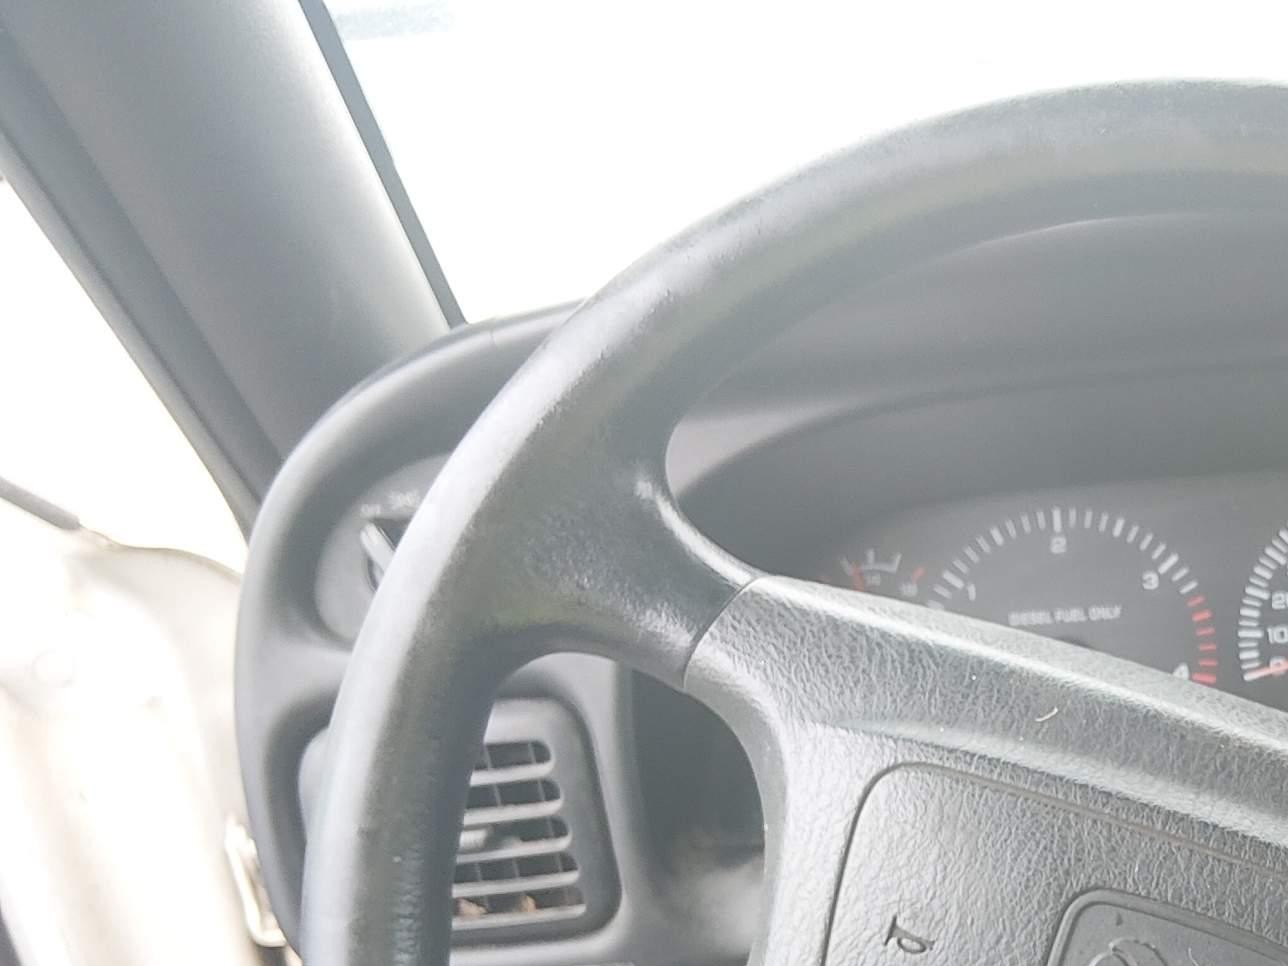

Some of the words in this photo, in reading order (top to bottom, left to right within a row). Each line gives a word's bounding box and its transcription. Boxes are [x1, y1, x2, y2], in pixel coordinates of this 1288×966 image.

[1050, 535, 1067, 554] 2
[1142, 570, 1160, 590] 3
[965, 583, 977, 601] 1
[1088, 603, 1122, 621] ONLY
